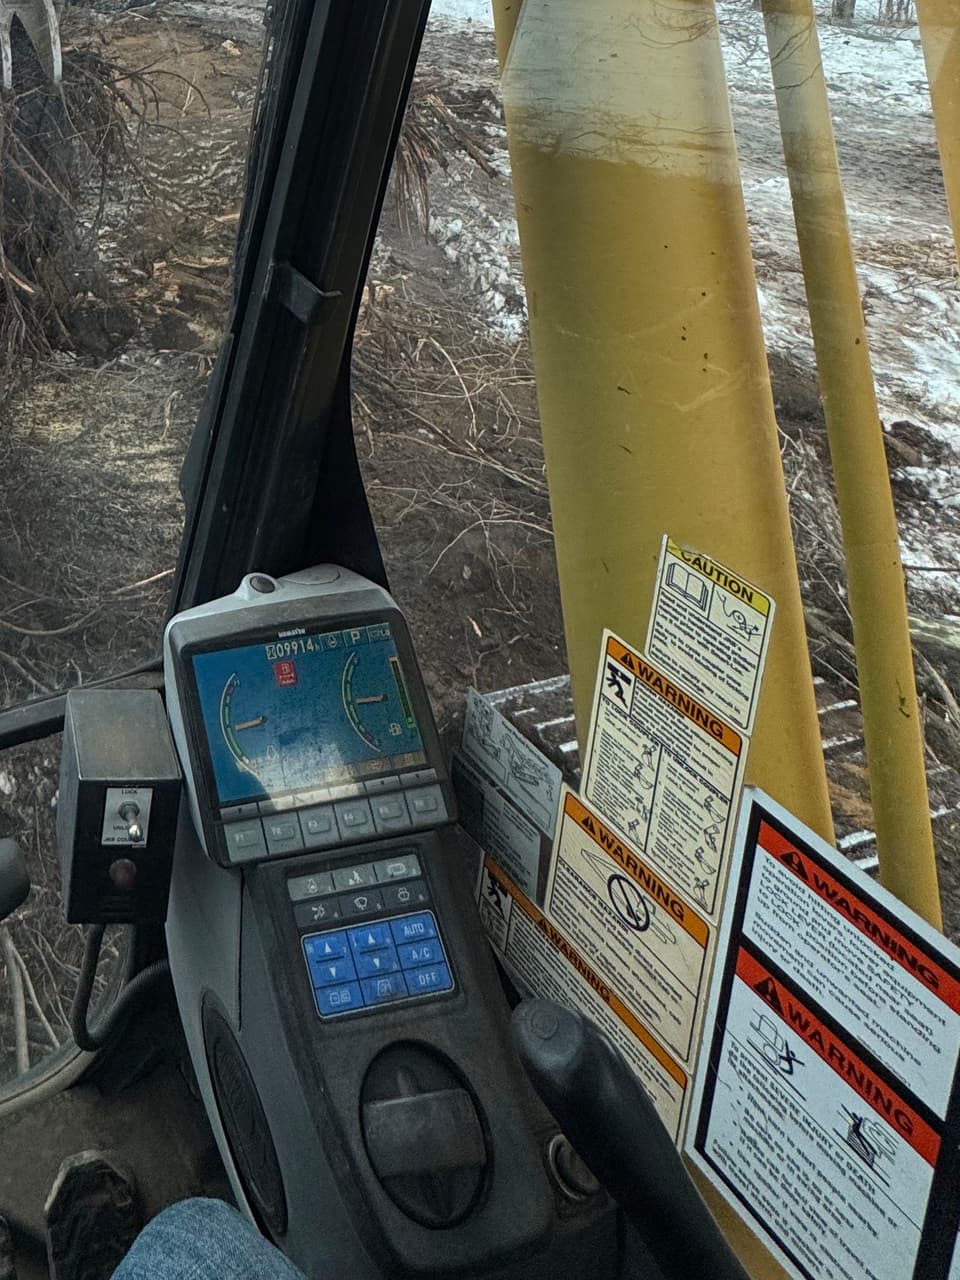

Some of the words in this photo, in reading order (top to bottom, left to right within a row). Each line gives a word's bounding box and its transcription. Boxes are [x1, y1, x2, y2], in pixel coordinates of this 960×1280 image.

[681, 552, 753, 604] CAUTION
[351, 631, 360, 644] P
[638, 661, 724, 740] WARNING
[599, 827, 685, 922] WARNING
[757, 895, 769, 911] up
[771, 908, 794, 932] from
[777, 867, 805, 894] avoid
[807, 892, 840, 926] hitting
[842, 923, 894, 972] unlocked
[404, 923, 425, 936] AUTO
[412, 947, 430, 960] A/C
[419, 972, 437, 985] OFF
[547, 926, 612, 1004] WARNING
[751, 926, 778, 955] injury
[779, 953, 790, 966] or
[758, 887, 768, 899] to
[770, 897, 800, 927] LOCK
[805, 929, 847, 971] position
[850, 968, 886, 1004] before
[888, 1003, 941, 1055] standing
[759, 879, 788, 908] LOCK
[791, 906, 826, 941] LEVER
[875, 981, 900, 1007] near
[761, 872, 770, 884] to
[773, 883, 809, 917] ground
[811, 916, 831, 936] and
[833, 935, 864, 965] move
[866, 963, 913, 1008] SAFETY
[762, 864, 809, 908] operation
[849, 938, 879, 968] lower
[882, 968, 946, 1027] equipment
[811, 872, 941, 990] WARNING
[753, 919, 804, 969] movement
[806, 969, 825, 989] can
[828, 988, 860, 1021] cause
[863, 1021, 905, 1062] serious
[754, 910, 792, 948] Sudden
[794, 947, 813, 968] and
[815, 967, 869, 1020] unwanted
[871, 1018, 921, 1067] machine
[786, 1001, 915, 1138] WARNING
[769, 1080, 800, 1116] SEVERE
[802, 1114, 832, 1151] INJURY
[846, 1160, 875, 1195] DEATH
